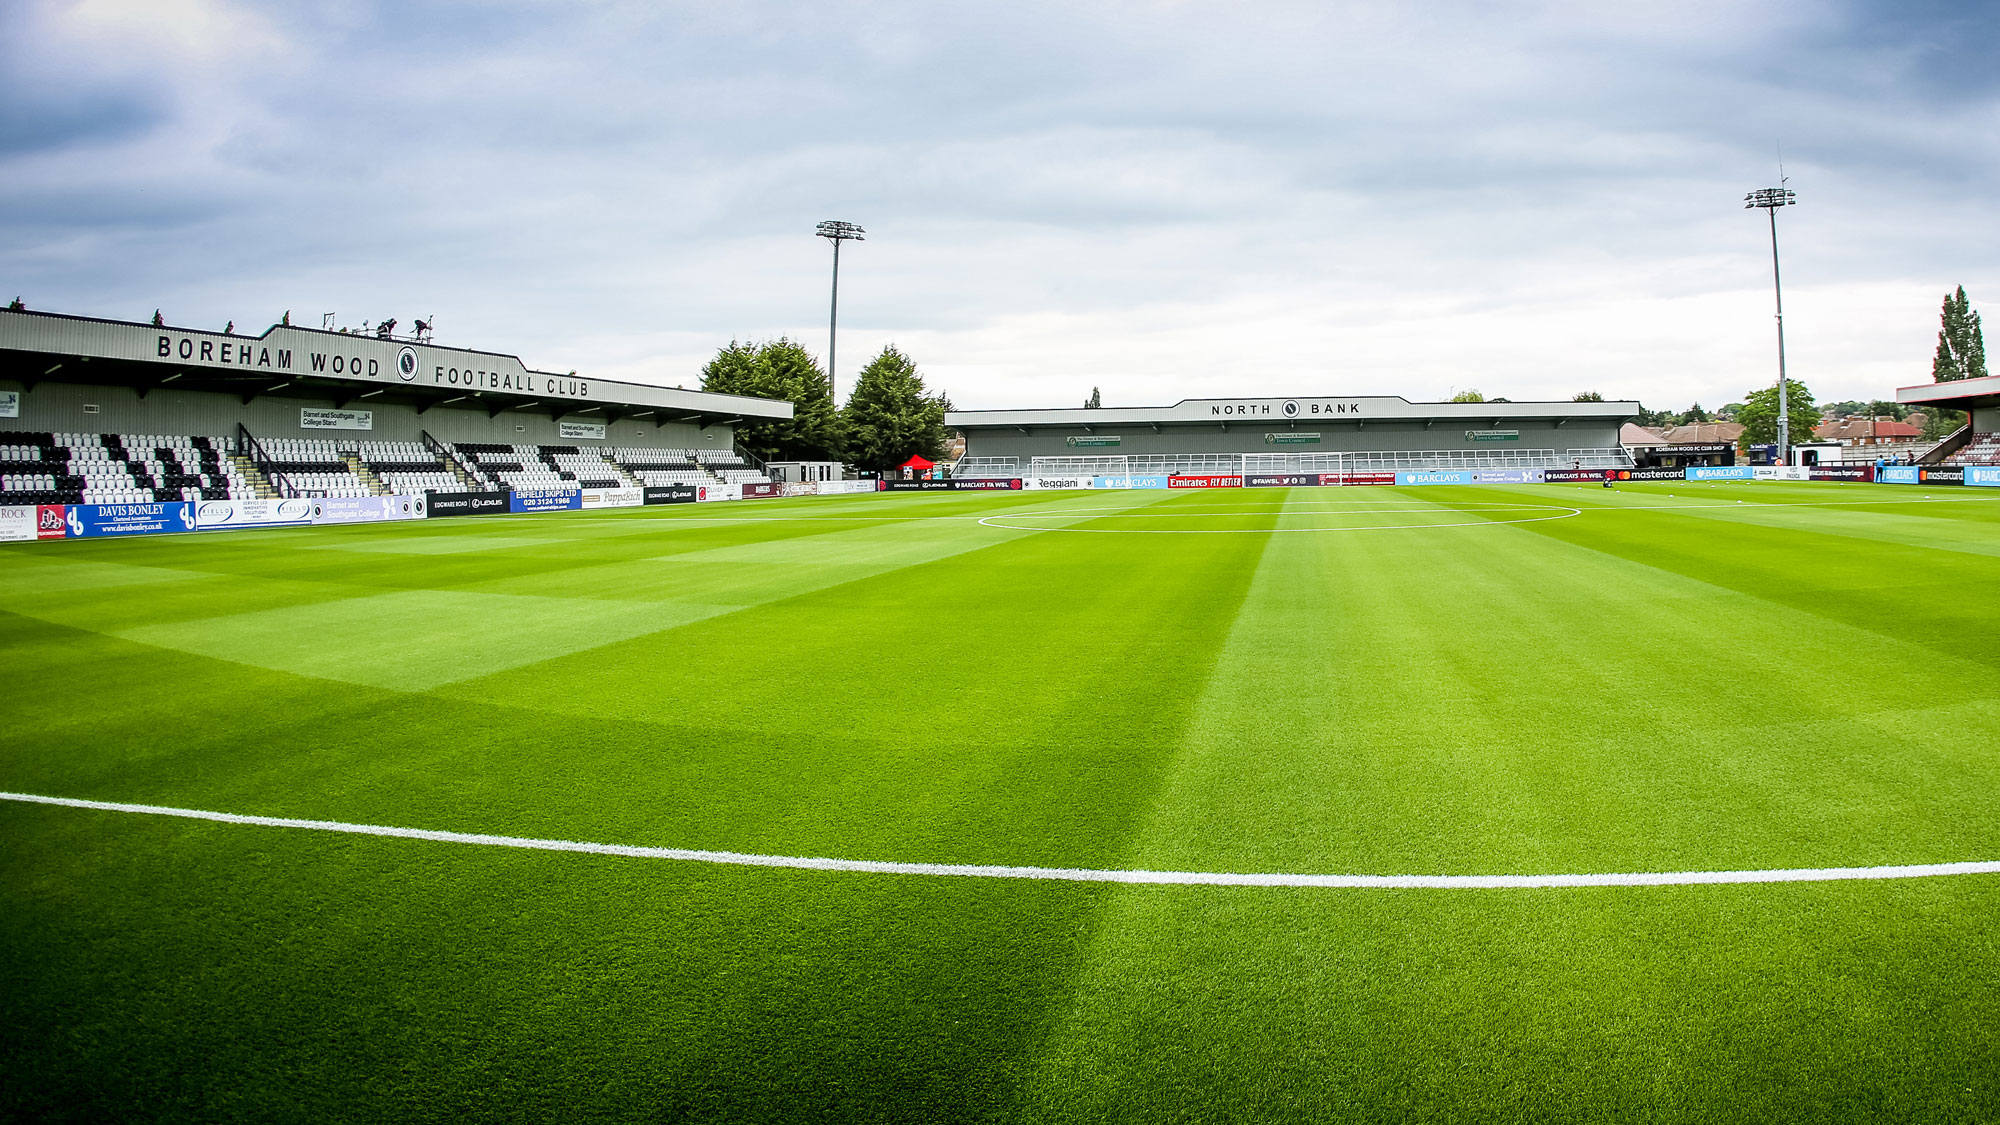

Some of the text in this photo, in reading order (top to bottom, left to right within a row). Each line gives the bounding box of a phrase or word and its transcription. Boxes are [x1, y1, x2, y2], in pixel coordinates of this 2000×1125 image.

[157, 335, 379, 377] BOREHAM WOOD
[434, 366, 589, 397] FOOTBALL CLUB
[1211, 403, 1360, 415] NORTH BANK
[330, 412, 355, 420] Southgate
[303, 418, 322, 426] College
[1417, 473, 1460, 483] BARCLAYS
[1631, 470, 1684, 478] mastercard
[1706, 469, 1744, 477] BARCLAYS
[1885, 469, 1914, 480] BARCLAYS
[1927, 470, 1964, 480] mastercard
[1038, 478, 1078, 489] Reggiani
[1115, 478, 1157, 487] BARCLAYS
[1170, 477, 1241, 487] Emirates FLY BETTER
[516, 489, 577, 499] ENFIELD SKIPS LTD
[434, 499, 468, 509] EDGWARE ROAD
[1, 508, 26, 519] ROCK
[98, 504, 164, 517] DAVIS BONLEY
[326, 509, 381, 519] Southgate College
